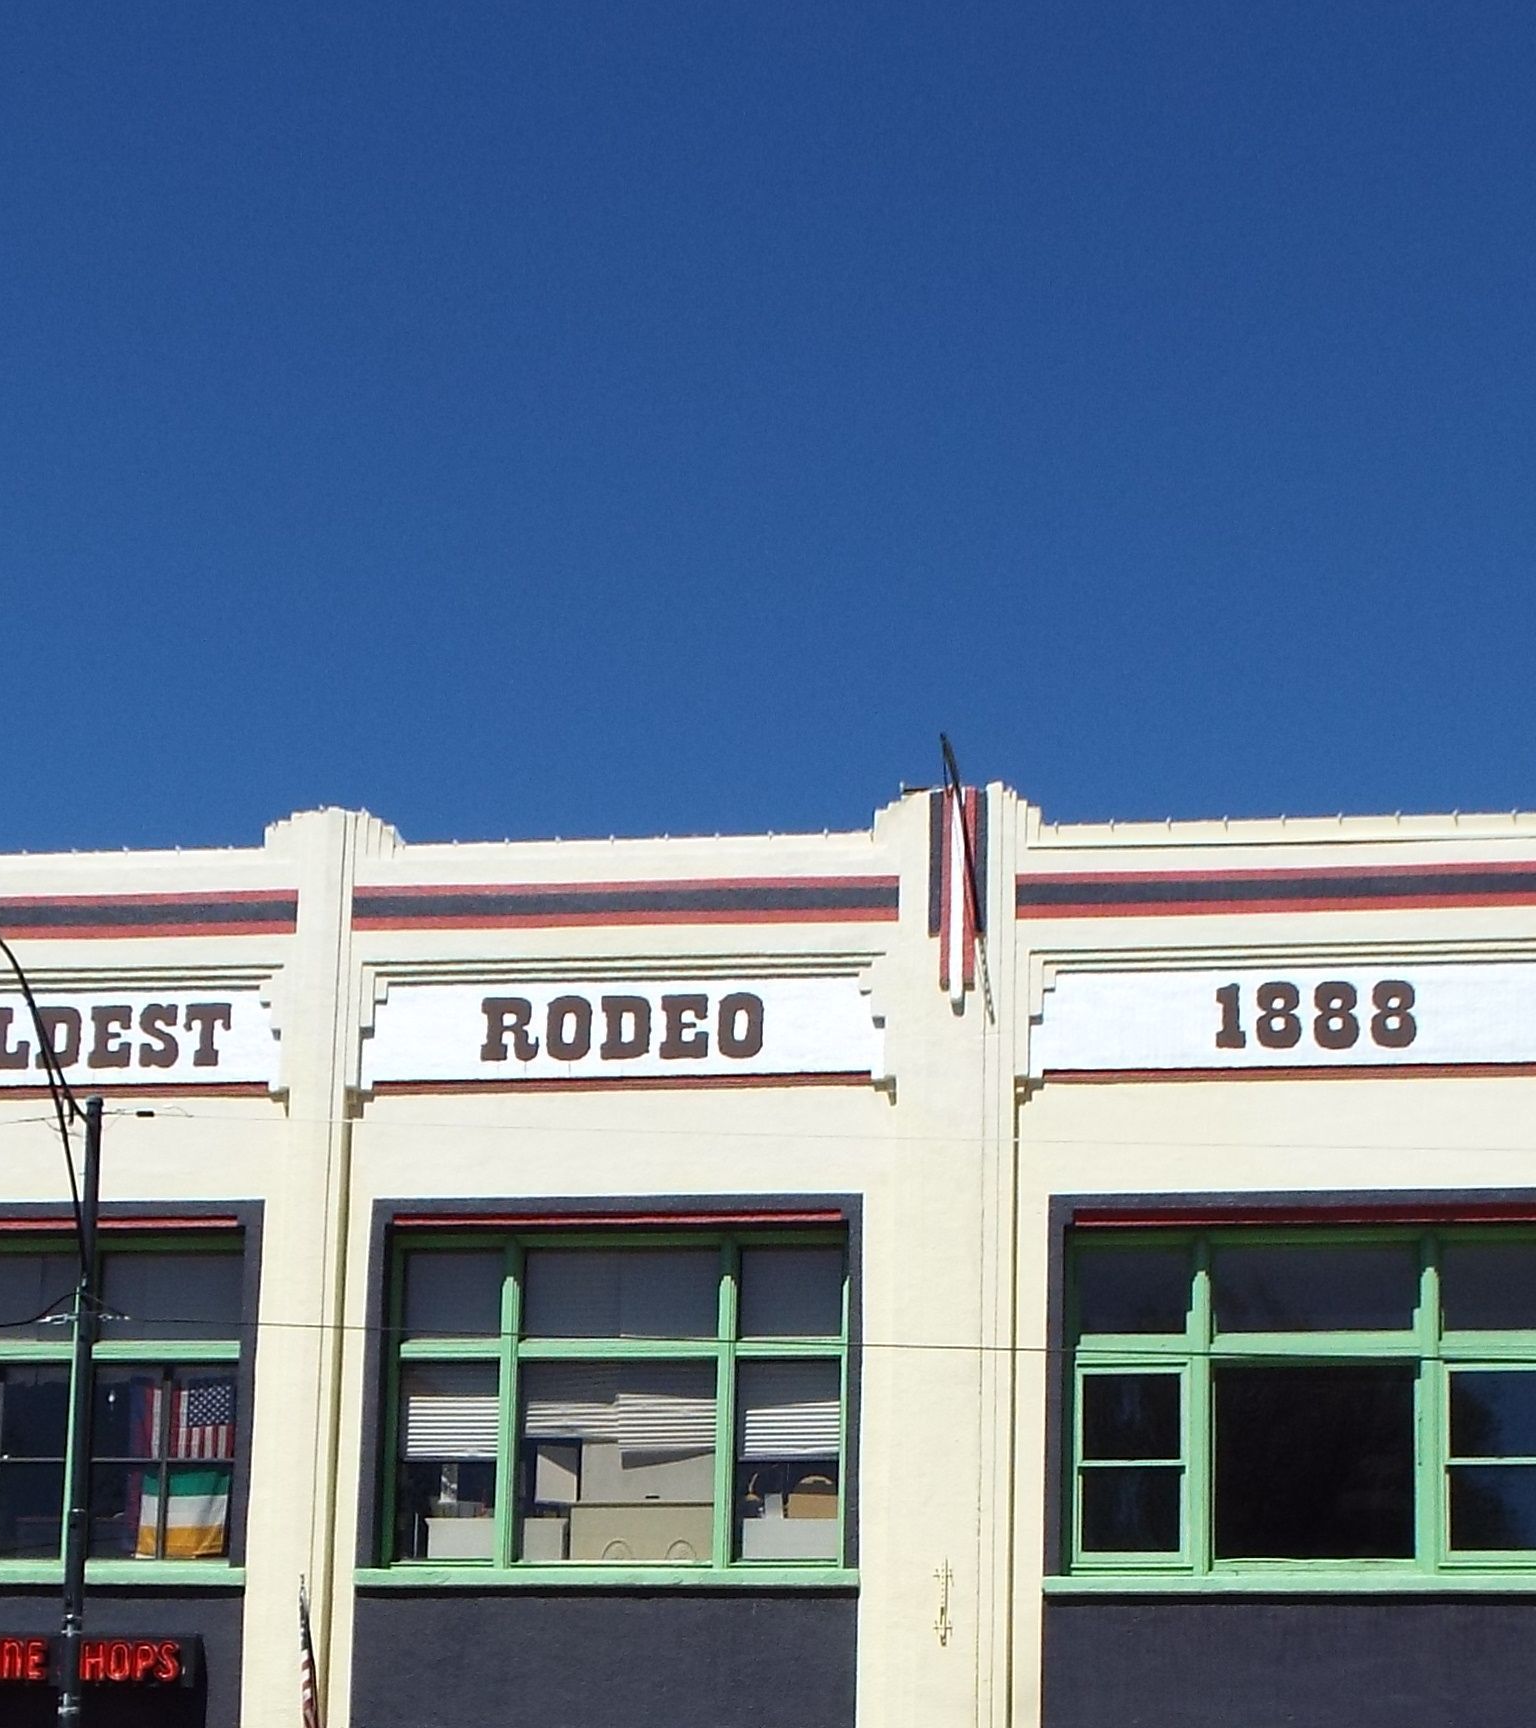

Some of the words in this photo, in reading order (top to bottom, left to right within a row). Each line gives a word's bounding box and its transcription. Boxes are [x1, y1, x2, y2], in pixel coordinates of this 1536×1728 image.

[480, 991, 764, 1061] RODEO
[1214, 980, 1418, 1050] 1888
[57, 1639, 182, 1682] HOPS
